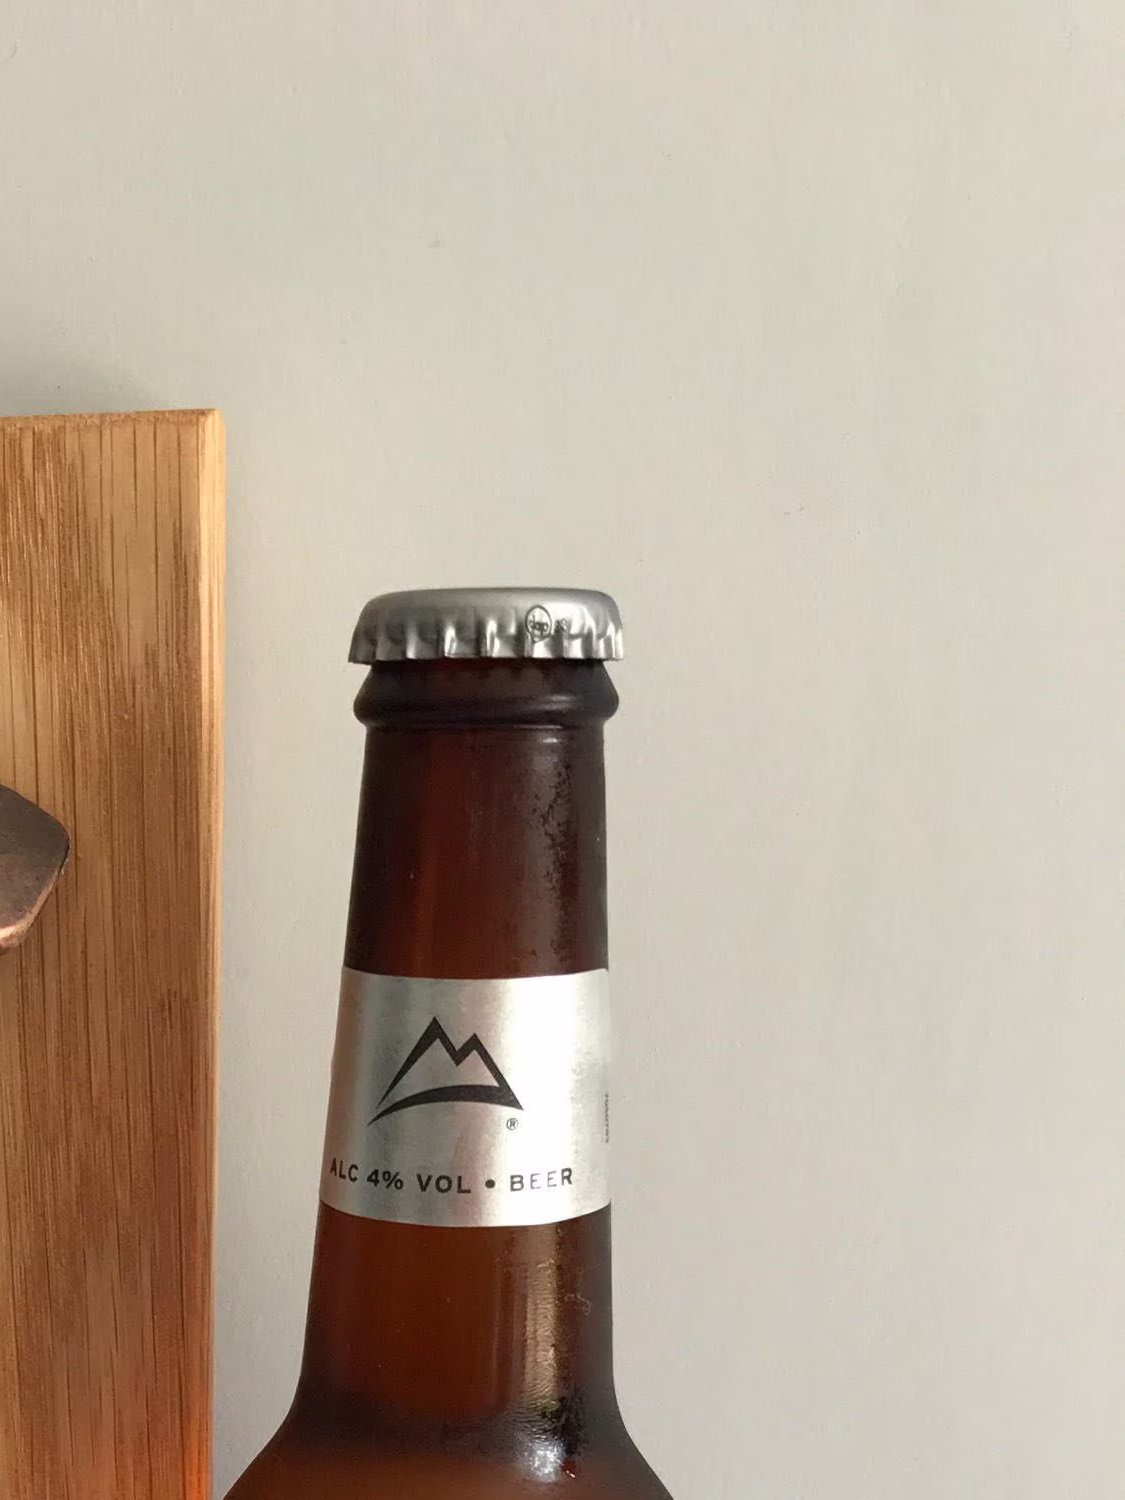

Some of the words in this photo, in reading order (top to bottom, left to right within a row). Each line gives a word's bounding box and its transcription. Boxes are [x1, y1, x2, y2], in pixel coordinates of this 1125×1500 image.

[329, 1157, 360, 1183] ALC
[366, 1169, 404, 1190] 4%
[416, 1173, 472, 1194] VOL
[509, 1167, 573, 1192] BEER
